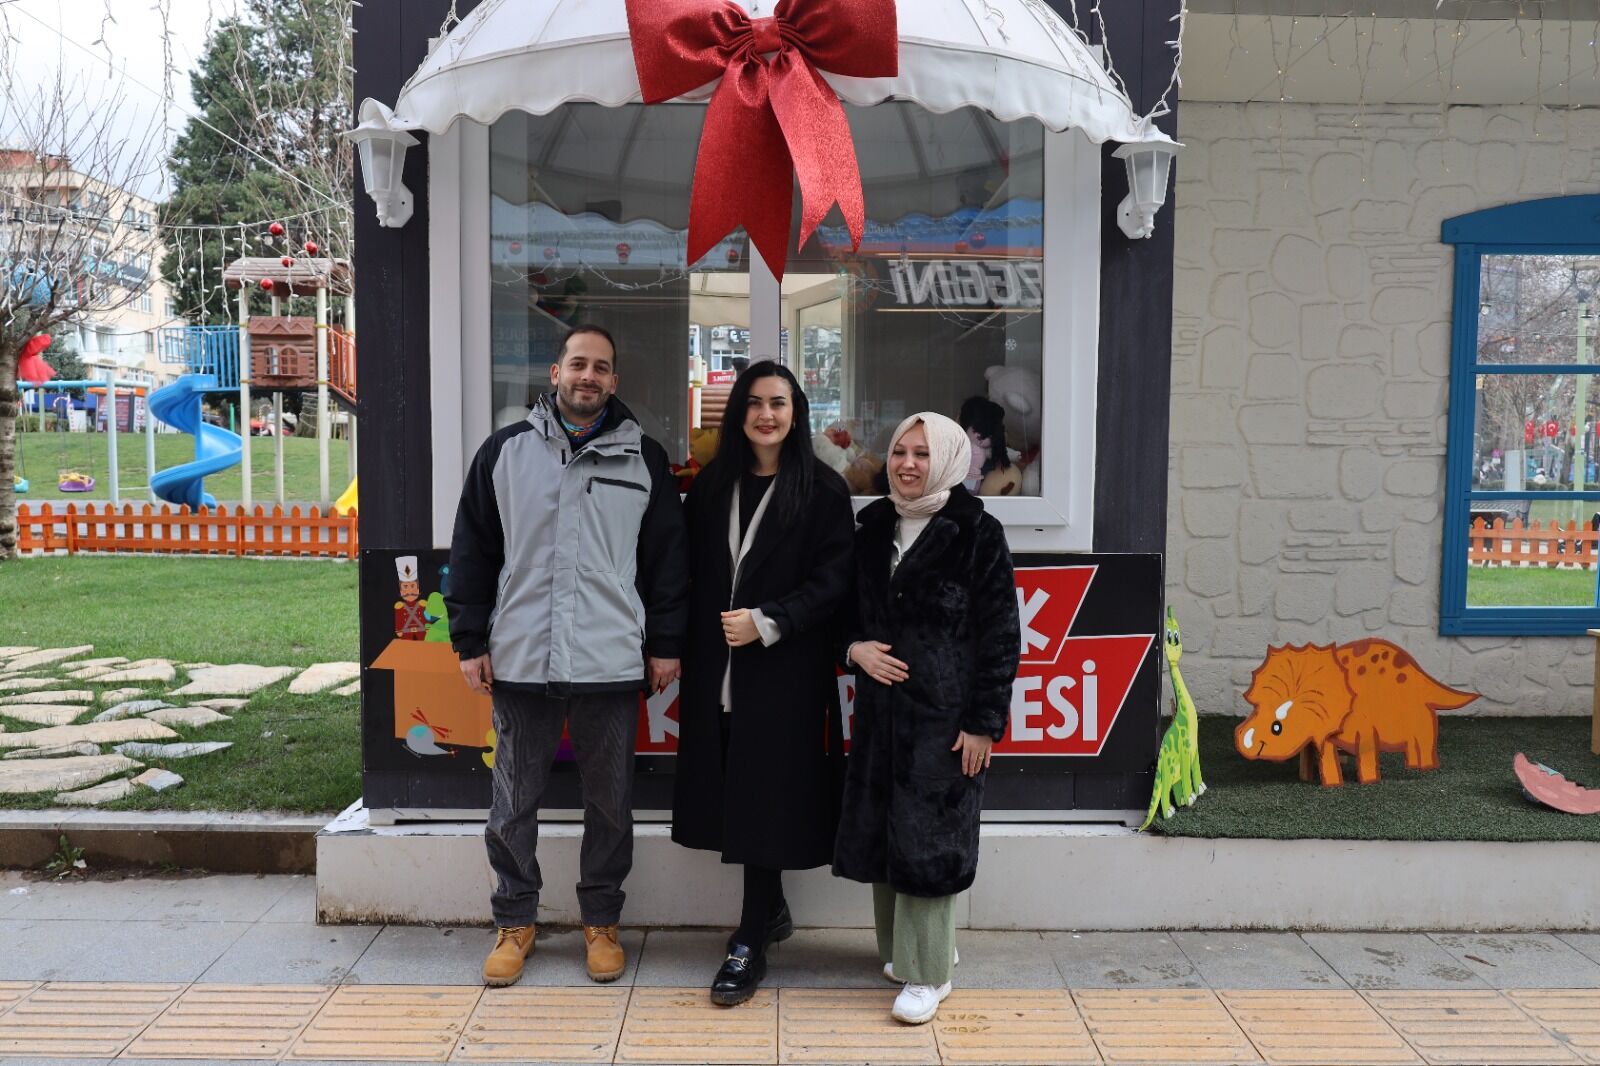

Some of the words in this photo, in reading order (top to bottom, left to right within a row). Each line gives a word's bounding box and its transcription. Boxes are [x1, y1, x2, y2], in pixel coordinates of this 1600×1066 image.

[1016, 587, 1051, 655] K
[646, 677, 680, 743] K
[1010, 659, 1098, 742] ESİ
